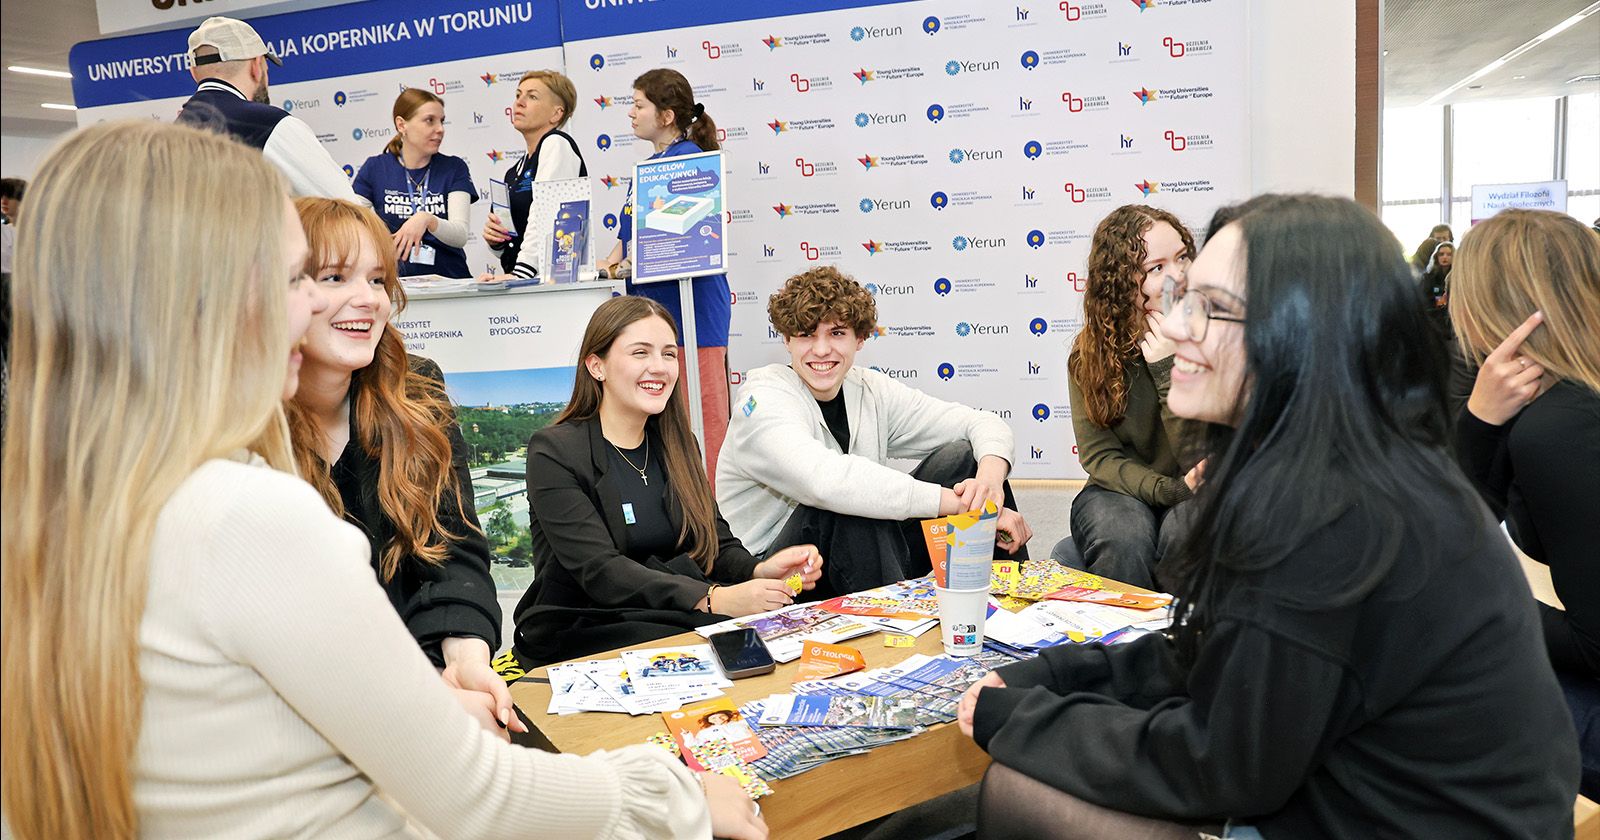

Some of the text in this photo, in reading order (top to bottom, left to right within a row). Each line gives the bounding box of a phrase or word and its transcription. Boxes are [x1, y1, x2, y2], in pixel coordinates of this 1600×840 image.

[864, 26, 902, 38] Yerun
[88, 53, 192, 82] UNIWERSYTE
[301, 21, 412, 55] KOPERNIKA
[413, 16, 435, 38] W
[438, 2, 532, 34] TORUNIU
[960, 60, 1000, 72] Yerun
[292, 99, 320, 110] Yerun
[869, 112, 906, 124] Yerun
[362, 128, 391, 138] Yerun
[964, 149, 1002, 160] Yerun
[639, 163, 685, 175] BOX CELÓW
[639, 169, 698, 184] EDUKACYJNYCH
[1488, 190, 1550, 200] Wydział Filozofii
[384, 204, 446, 215] MEDCUM
[873, 199, 911, 210] Yerun
[967, 236, 1006, 248] Yerun
[877, 284, 914, 295] Yerun
[488, 314, 519, 324] TORUŃ
[490, 326, 541, 336] BYDGOSZCZ
[970, 323, 1009, 334] Yerun
[420, 330, 463, 339] KOPERNIKA
[880, 368, 918, 378] Yerun
